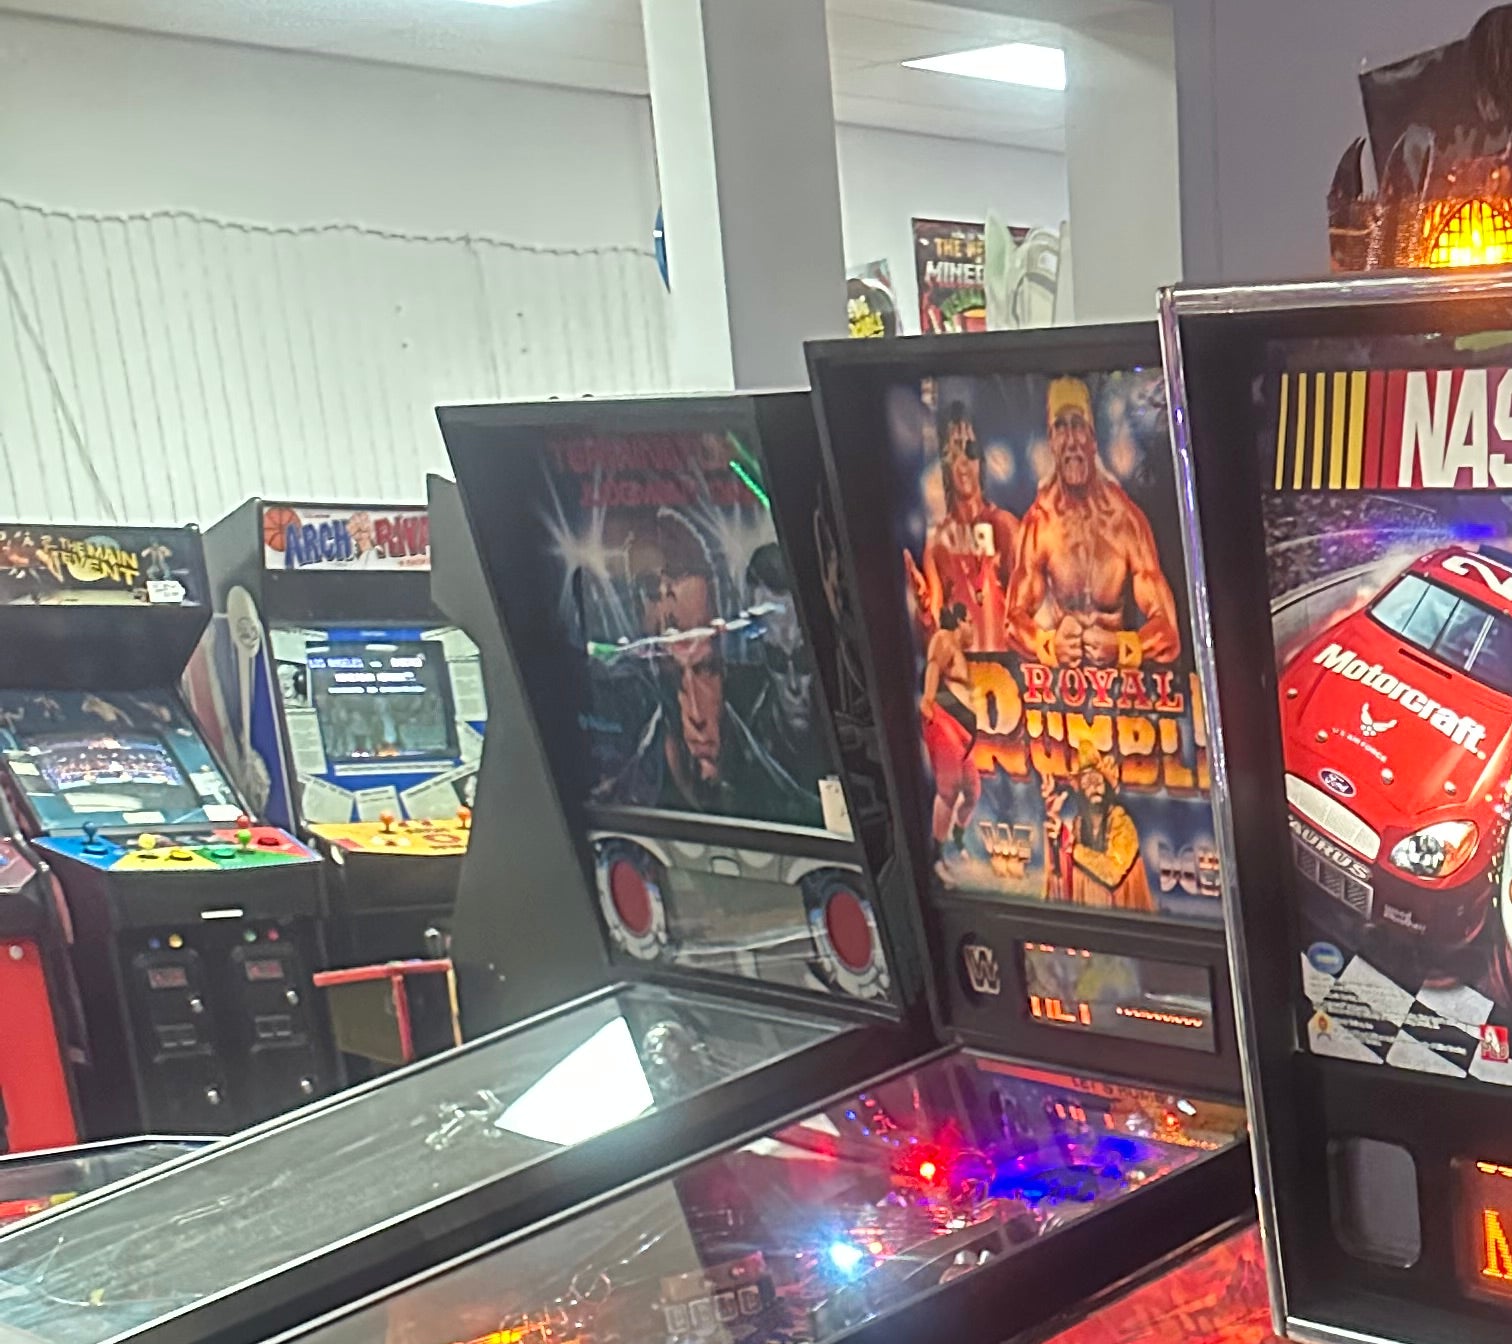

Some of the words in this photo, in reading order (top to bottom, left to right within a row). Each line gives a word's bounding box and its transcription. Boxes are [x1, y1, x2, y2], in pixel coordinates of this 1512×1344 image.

[60, 551, 140, 586] EVENT
[85, 543, 140, 570] MAIN
[284, 518, 350, 569] ARCH
[1020, 662, 1185, 713] ROYAL
[1312, 643, 1482, 756] Motorcraft
